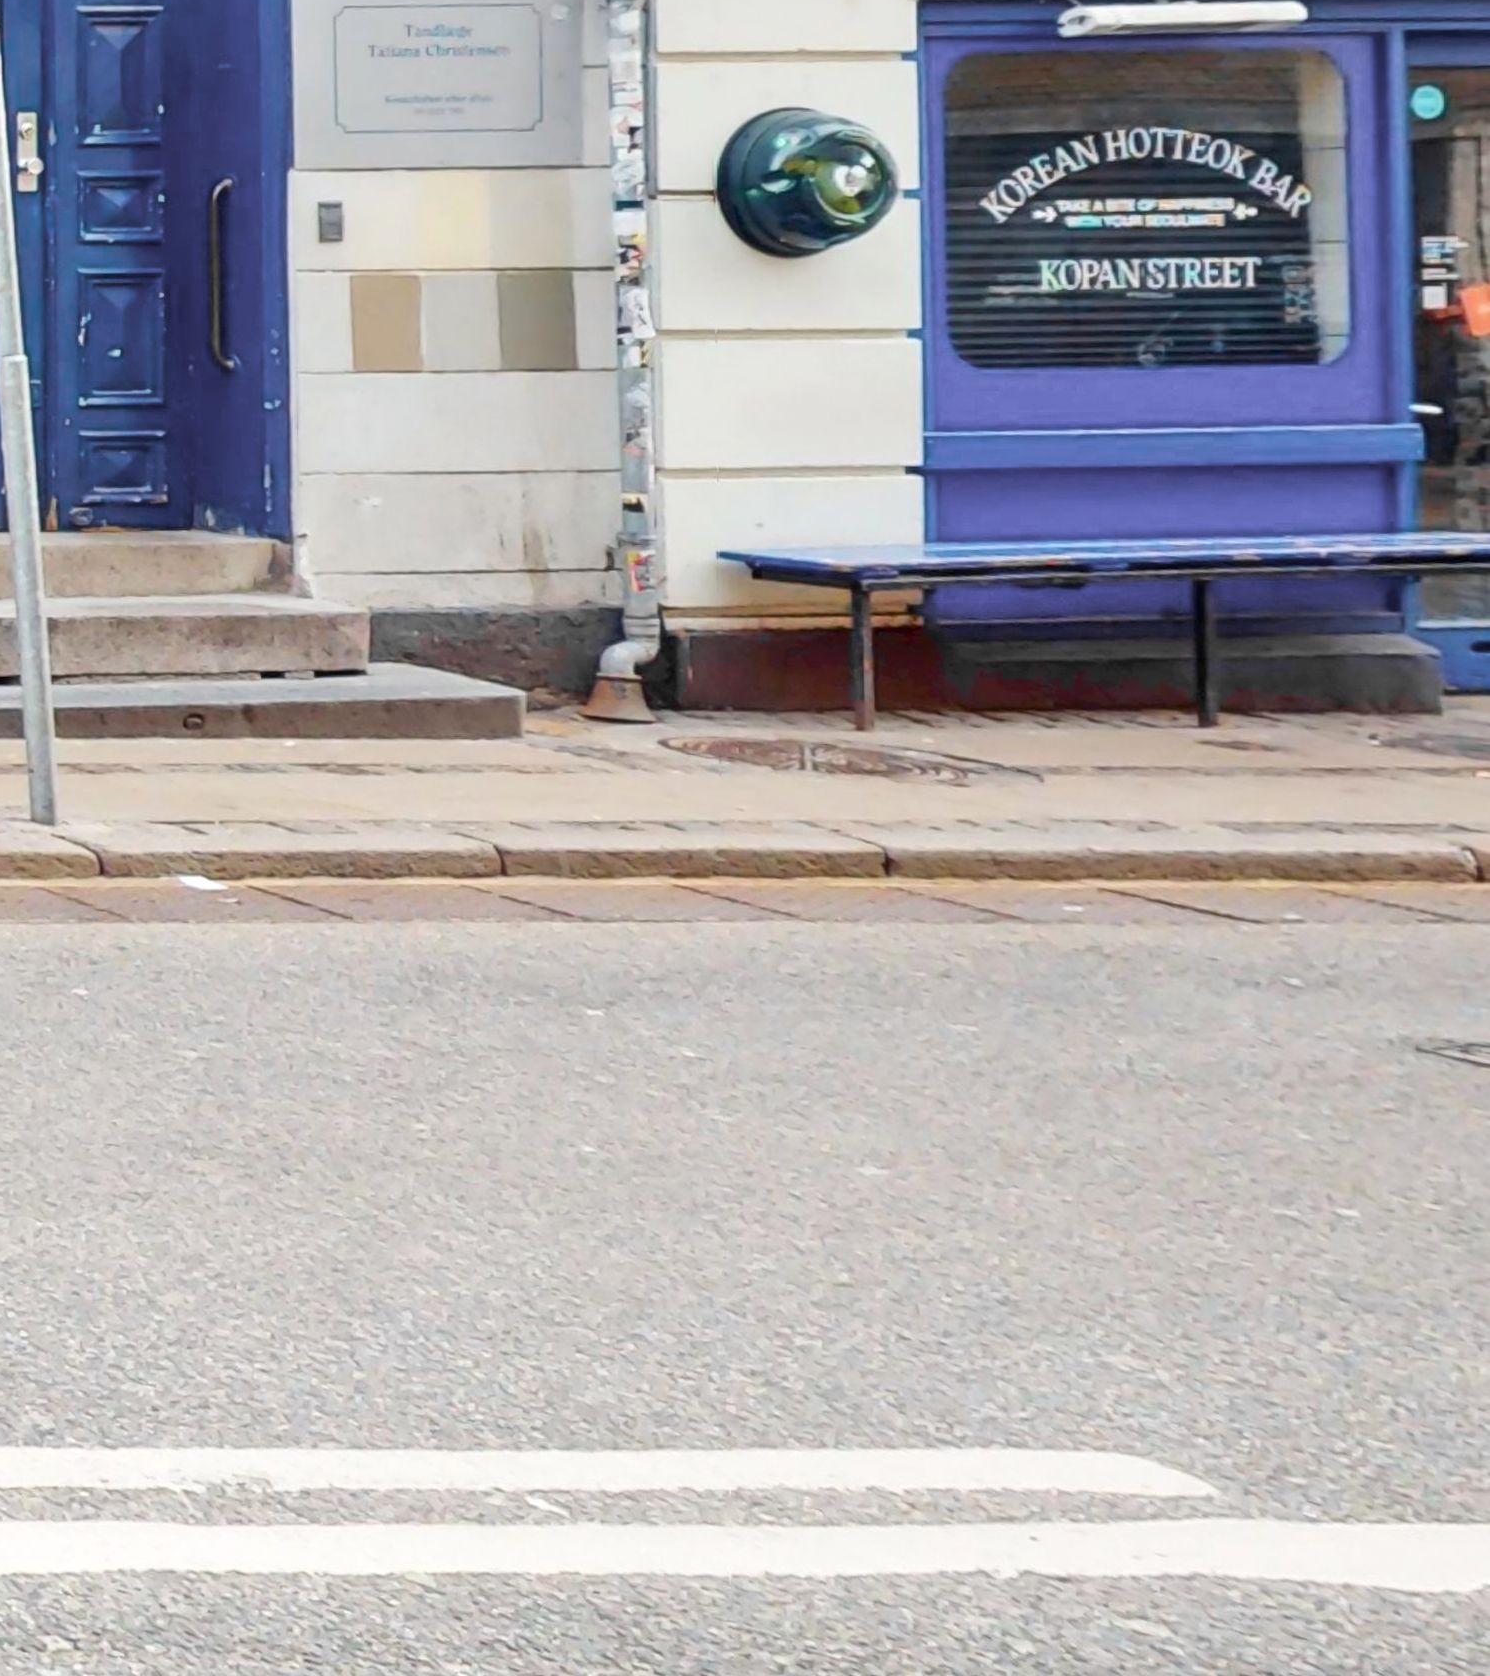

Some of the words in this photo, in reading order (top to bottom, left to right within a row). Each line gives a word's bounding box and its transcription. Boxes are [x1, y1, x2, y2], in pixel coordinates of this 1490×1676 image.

[979, 134, 1100, 224] KOREAN
[1102, 127, 1257, 179] HOTTEOK
[1248, 157, 1313, 219] BAR
[1038, 258, 1140, 291] KOPAN
[1146, 257, 1262, 289] STREET
